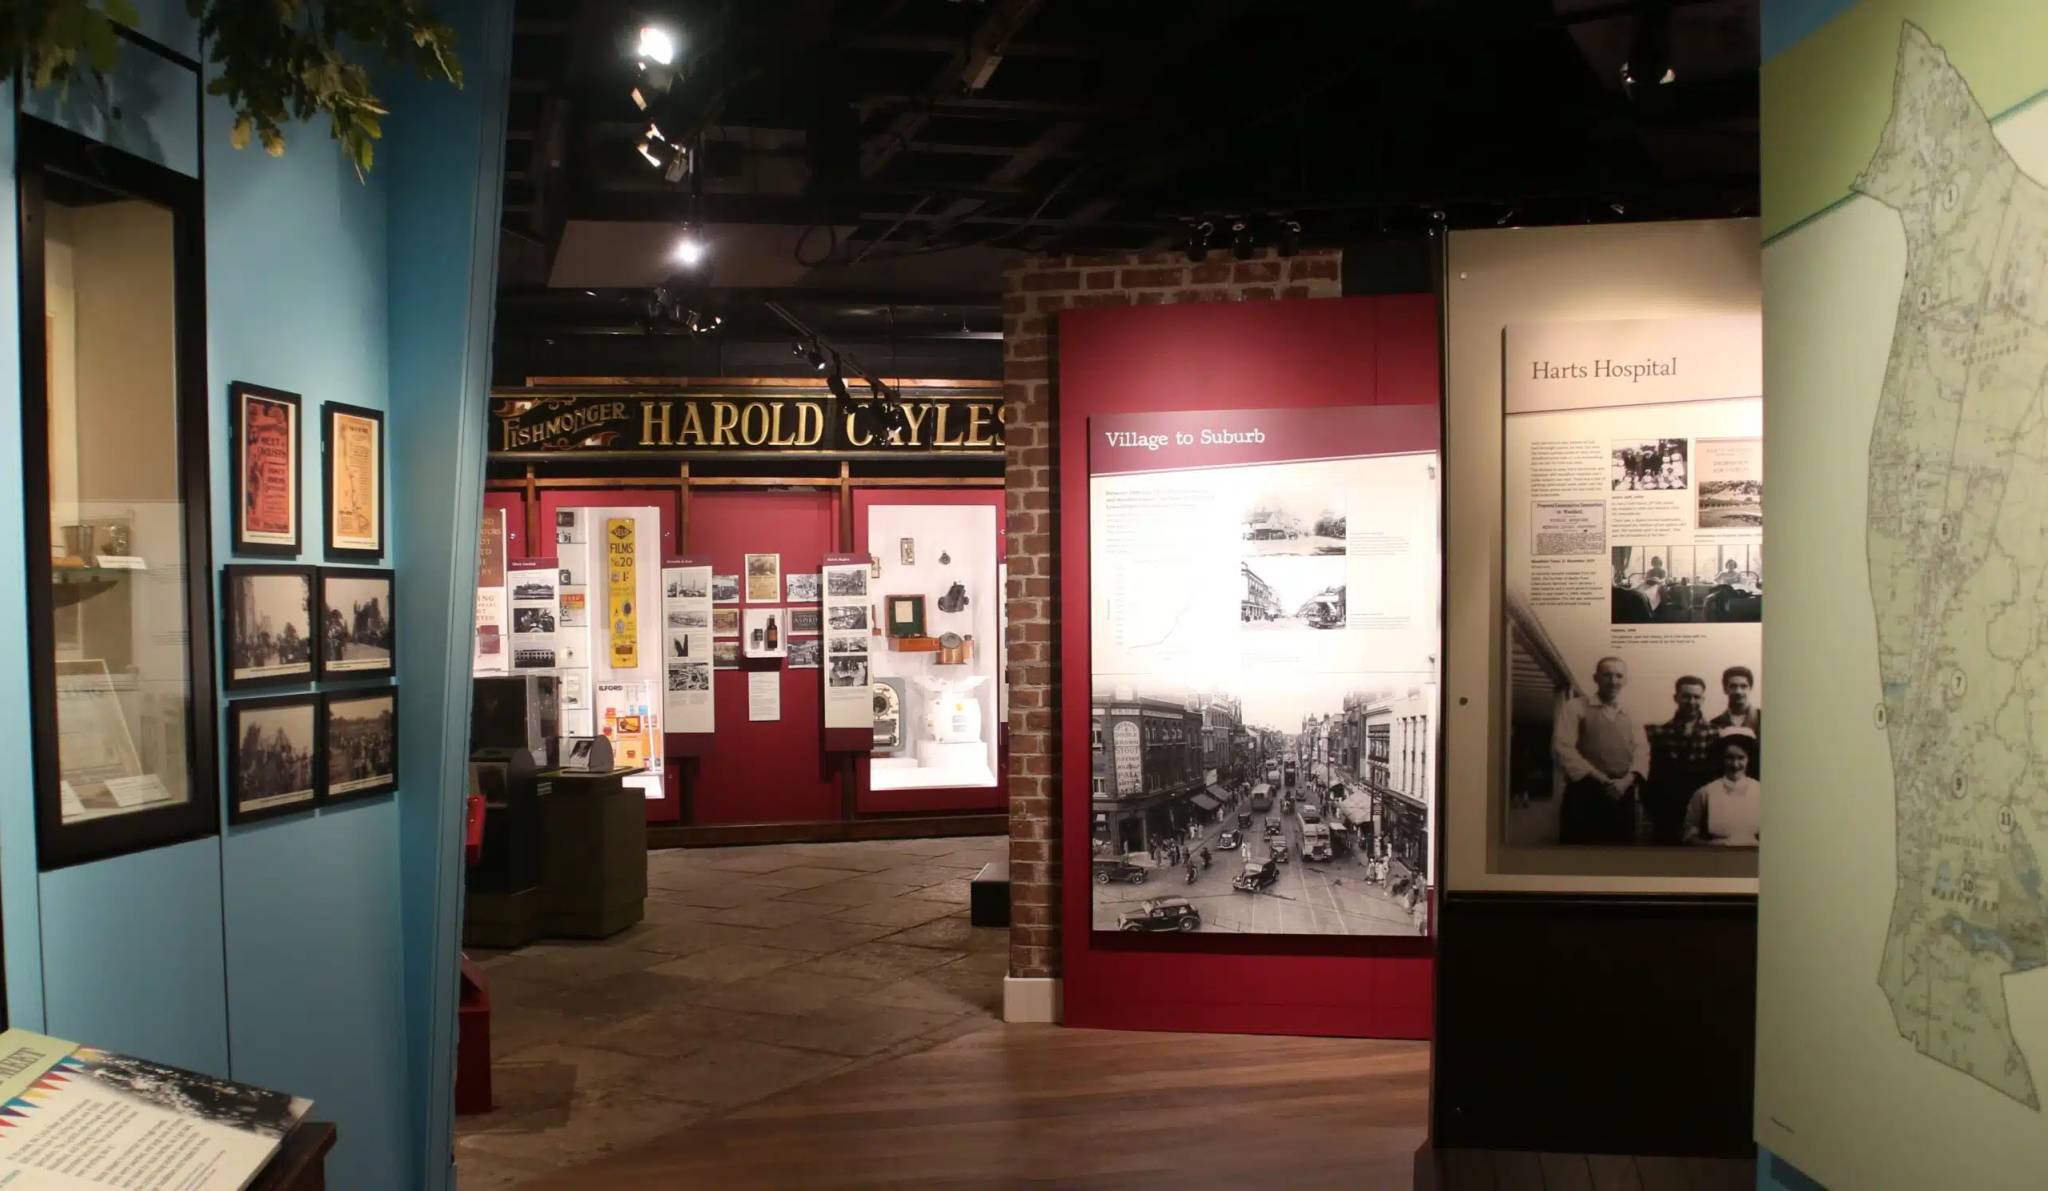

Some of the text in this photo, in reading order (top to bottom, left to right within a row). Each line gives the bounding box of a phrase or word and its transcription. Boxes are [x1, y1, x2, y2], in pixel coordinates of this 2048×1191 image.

[1531, 357, 1678, 383] Harts Hospital
[502, 402, 625, 451] FISHMONGER
[640, 400, 825, 447] HAROLD
[1105, 428, 1265, 451] Village to Suburb
[609, 543, 634, 554] FILMS
[2001, 812, 2011, 826] 11
